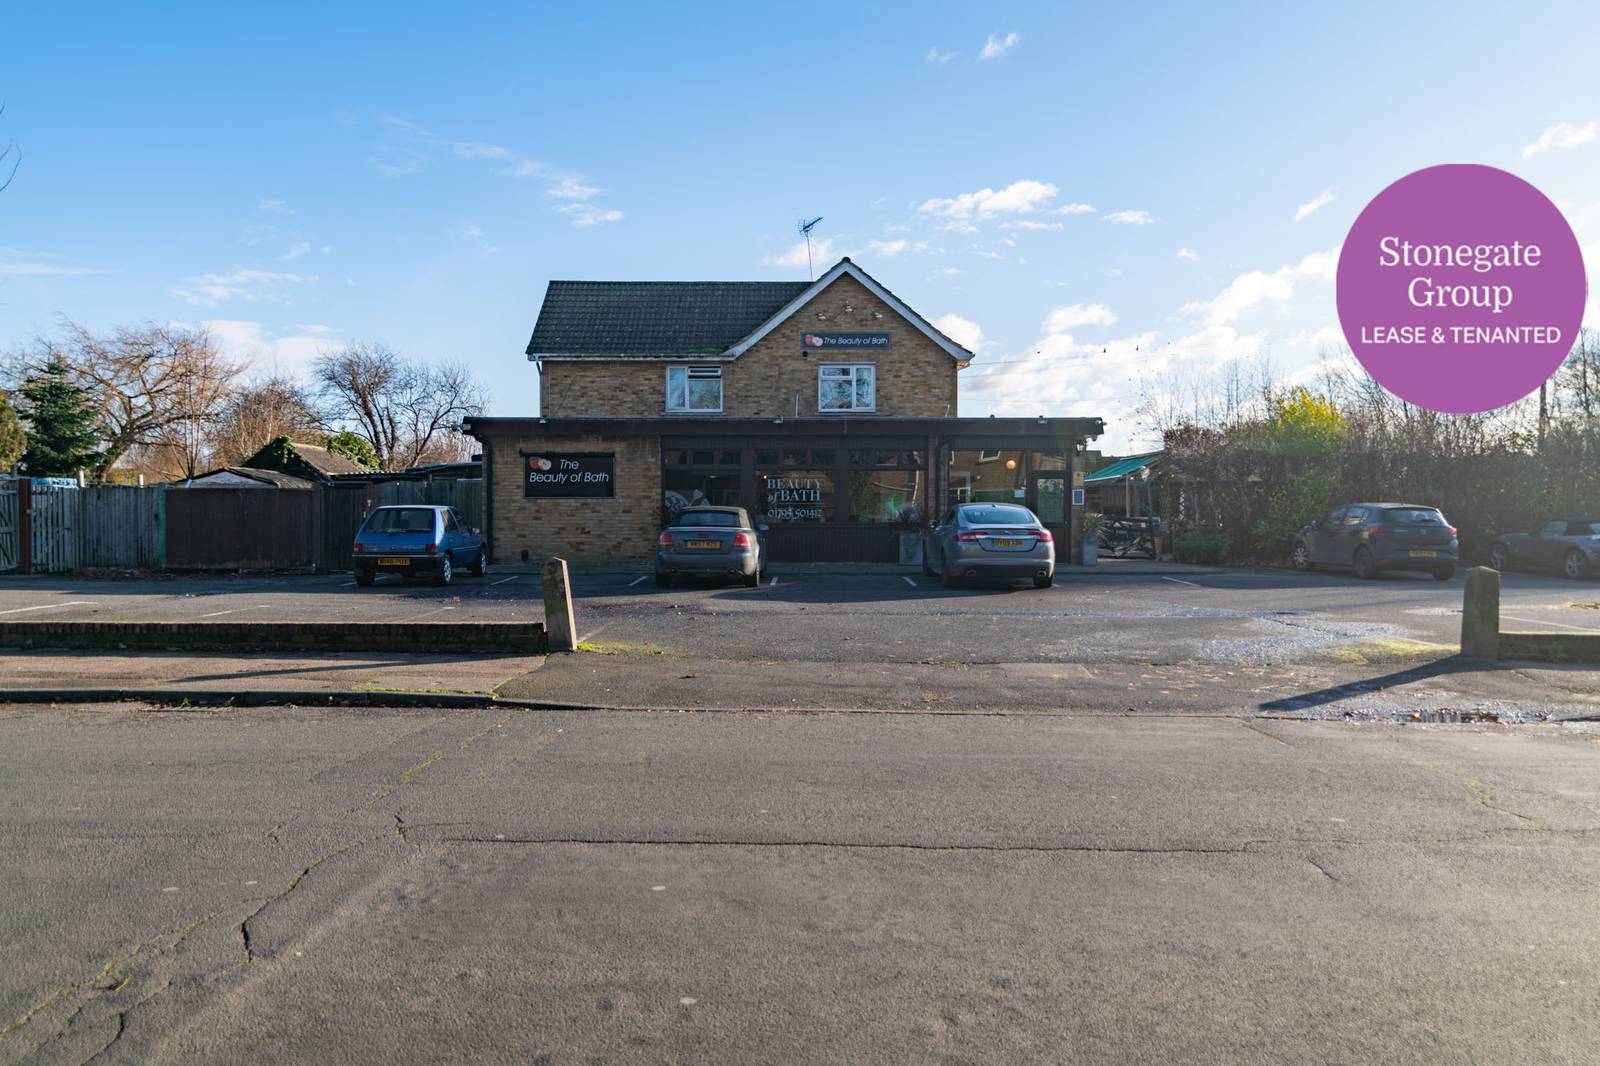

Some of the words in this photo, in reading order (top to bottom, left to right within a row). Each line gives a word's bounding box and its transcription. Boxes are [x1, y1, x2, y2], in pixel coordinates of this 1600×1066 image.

[824, 337, 836, 345] The
[837, 337, 861, 346] Beauty
[863, 337, 870, 345] of
[871, 337, 888, 345] Bath
[560, 459, 580, 470] The
[529, 472, 568, 484] Beauty
[570, 472, 582, 482] of
[584, 472, 609, 482] Bath
[767, 479, 822, 489] BEAUTY
[767, 492, 780, 505] of
[780, 489, 821, 501] BATH
